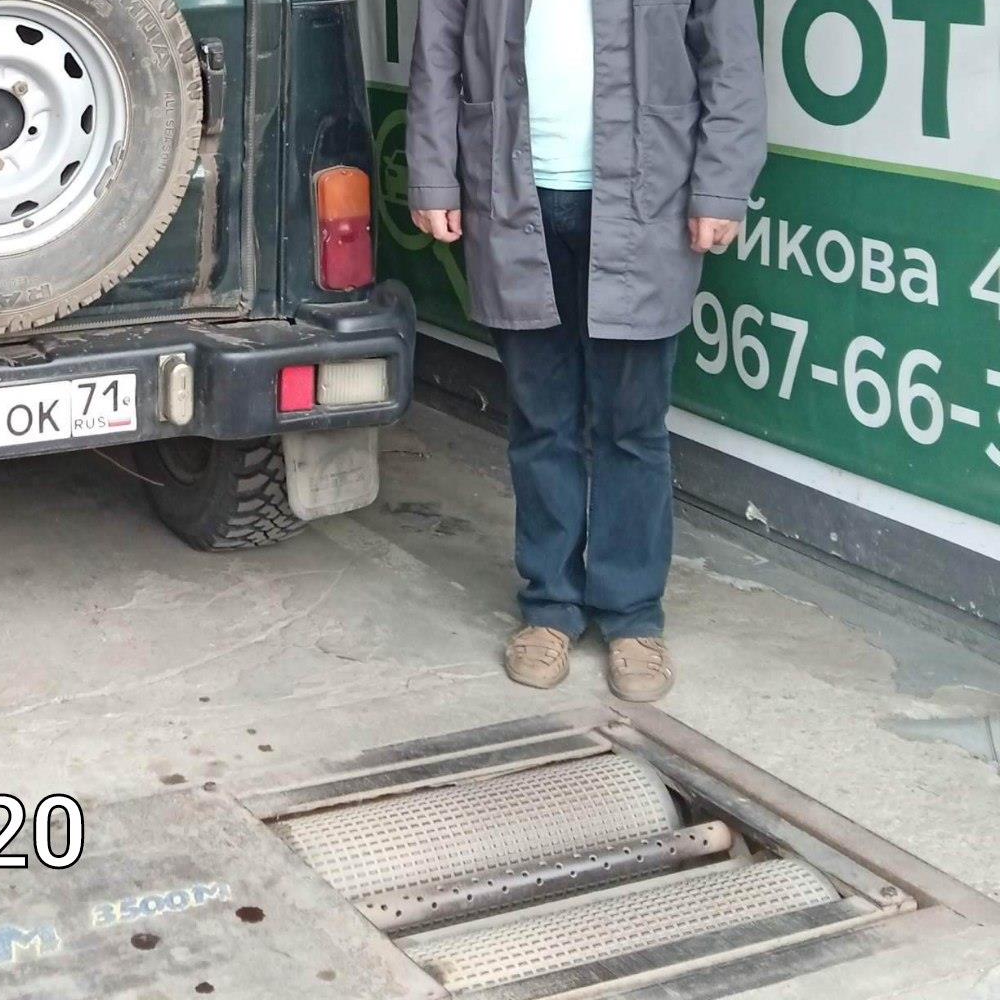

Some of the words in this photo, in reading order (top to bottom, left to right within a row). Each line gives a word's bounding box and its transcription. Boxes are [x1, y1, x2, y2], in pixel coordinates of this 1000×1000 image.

[708, 196, 940, 307] йкова
[77, 379, 119, 416] 71
[692, 291, 1000, 467] 967-66-
[74, 415, 107, 430] RUS
